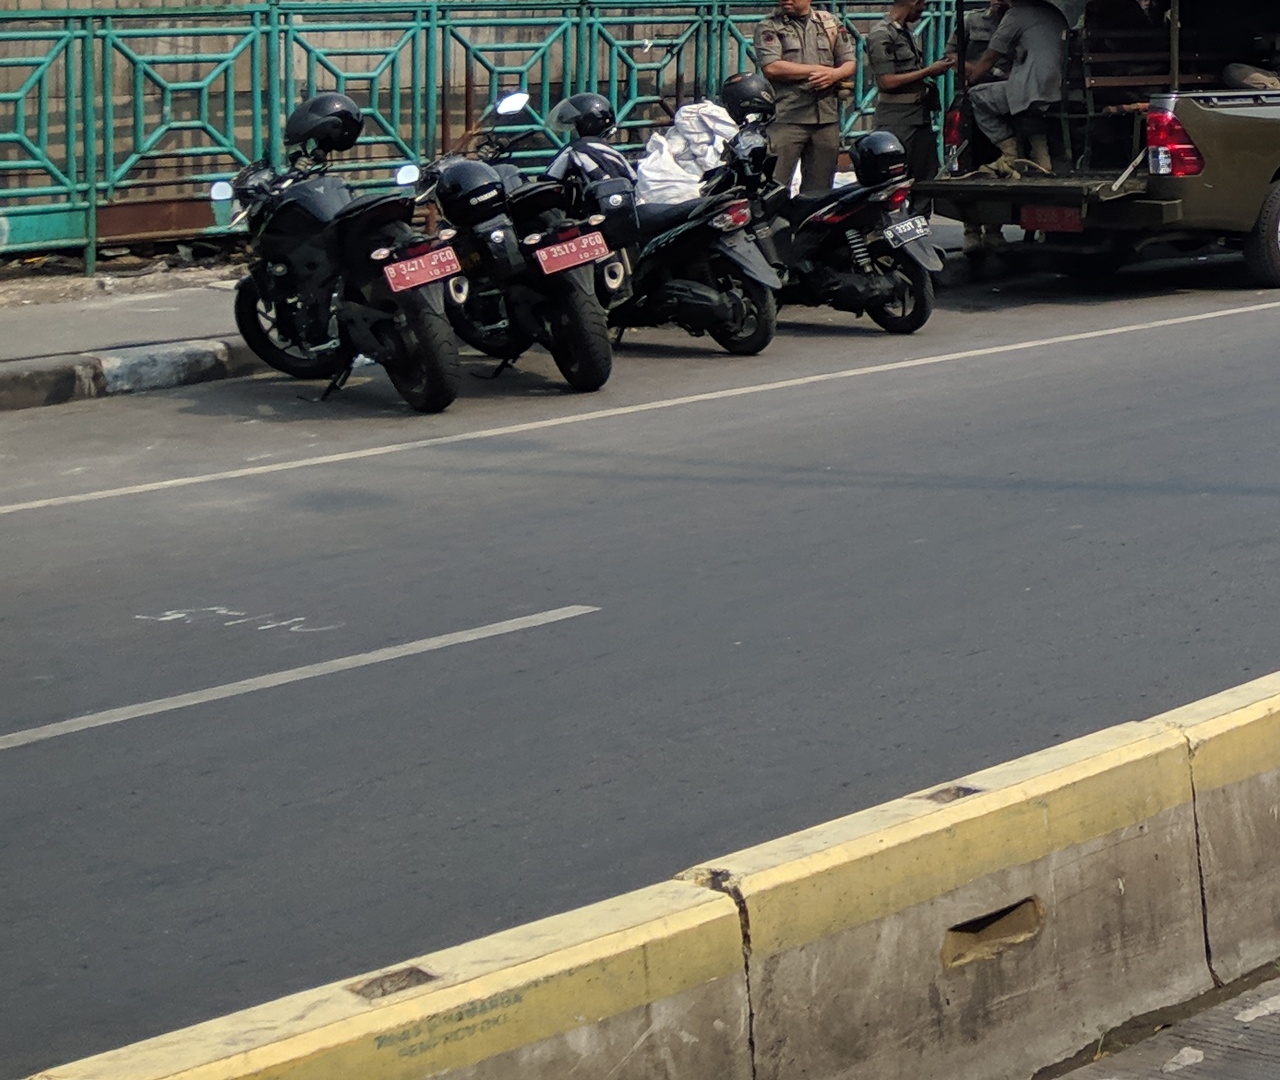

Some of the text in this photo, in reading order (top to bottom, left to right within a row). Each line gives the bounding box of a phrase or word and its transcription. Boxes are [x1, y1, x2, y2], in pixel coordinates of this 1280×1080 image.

[885, 230, 894, 239] B
[539, 250, 548, 261] B
[550, 242, 577, 258] 3513
[387, 267, 396, 278] B
[399, 258, 426, 275] 3471
